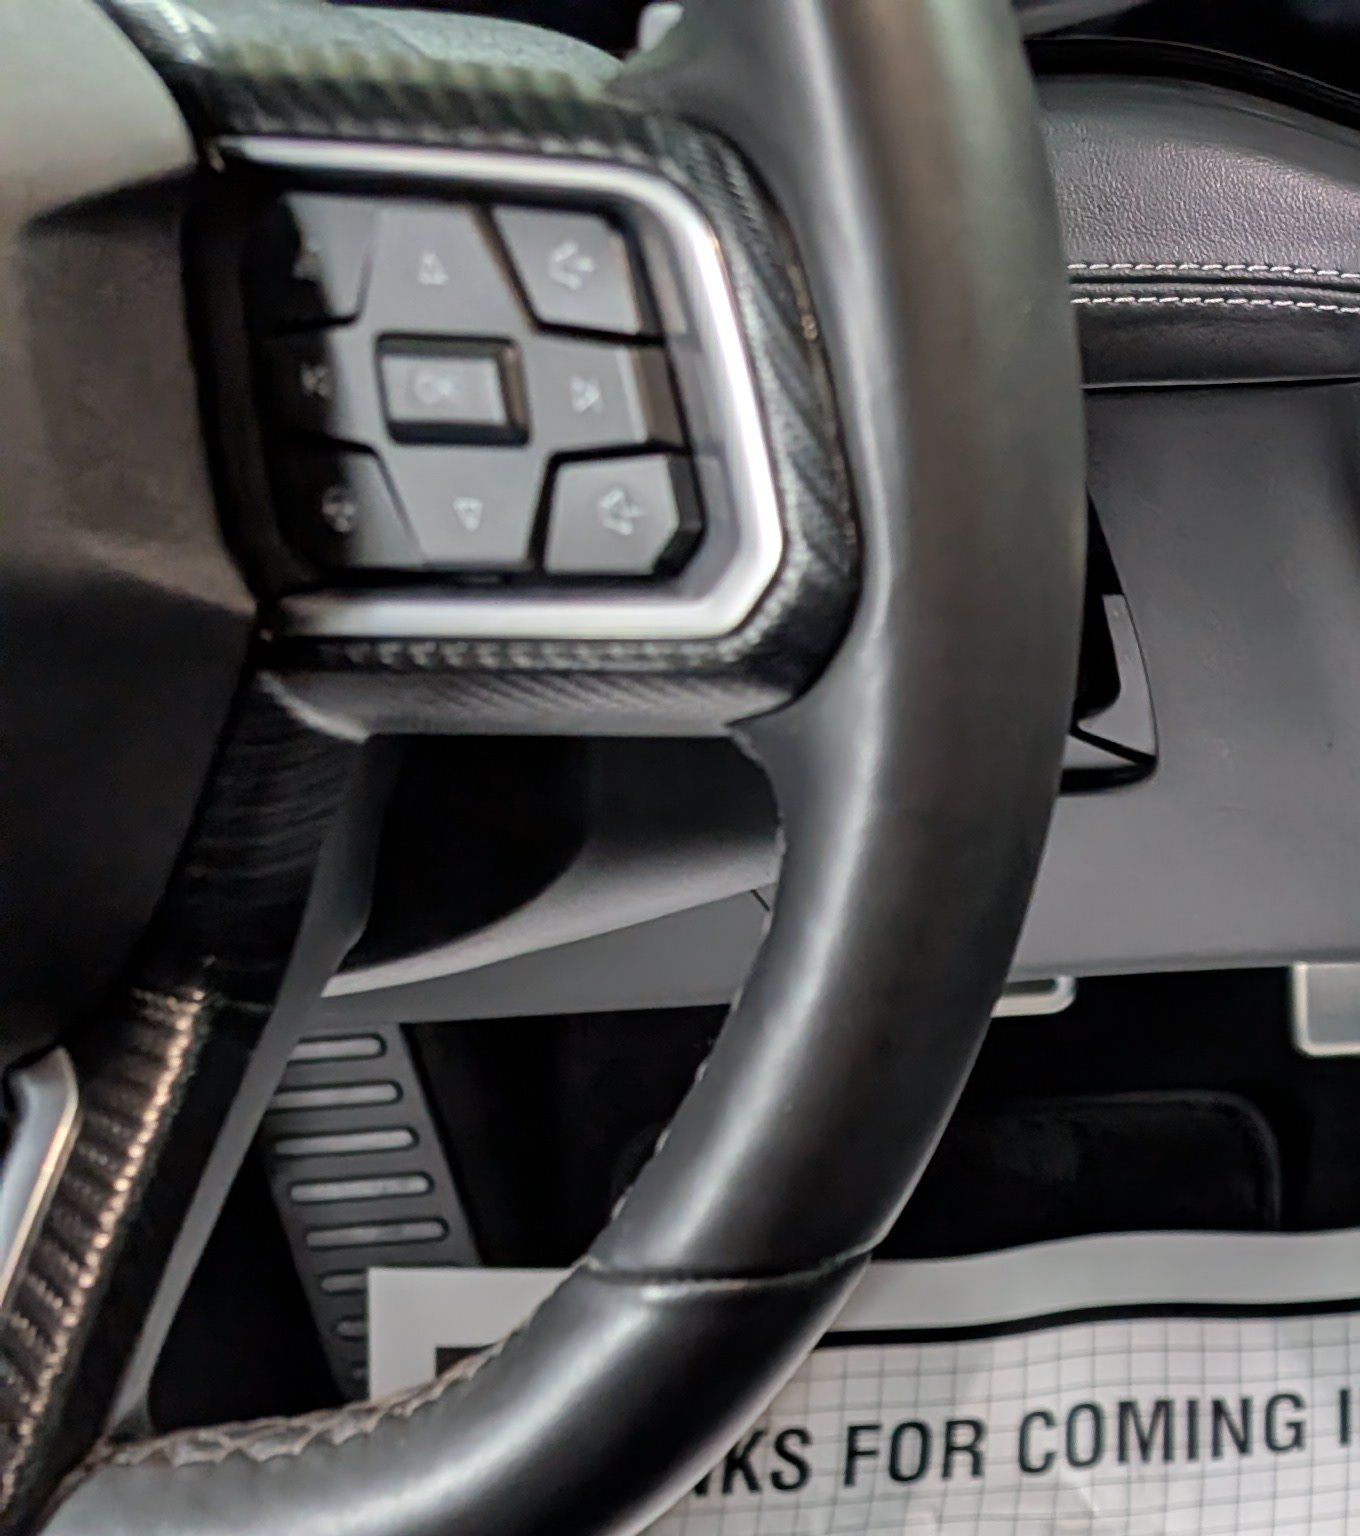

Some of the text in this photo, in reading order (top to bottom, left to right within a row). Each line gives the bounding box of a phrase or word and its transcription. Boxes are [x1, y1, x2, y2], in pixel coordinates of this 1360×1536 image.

[694, 1427, 812, 1496] KS
[843, 1418, 987, 1487] FOR
[1017, 1392, 1307, 1476] COMING
